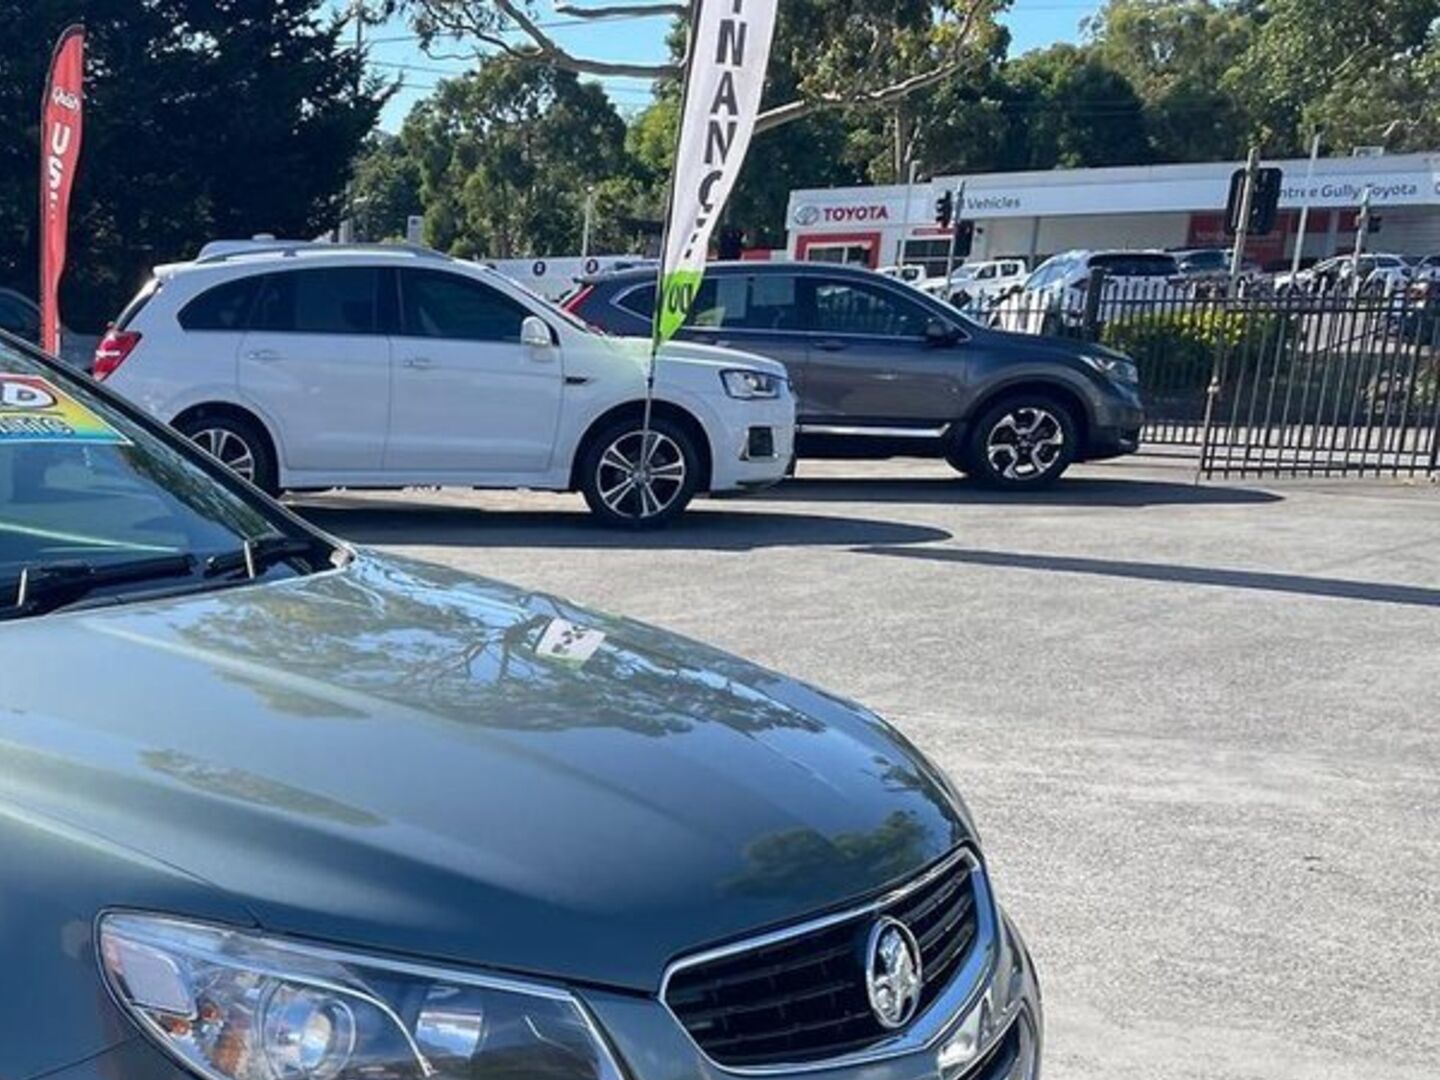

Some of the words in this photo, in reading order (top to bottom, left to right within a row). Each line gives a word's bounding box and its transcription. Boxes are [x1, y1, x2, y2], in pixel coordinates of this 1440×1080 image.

[1321, 183, 1360, 201] Gully
[966, 196, 1021, 210] Vehicles
[823, 205, 889, 222] TOYOTA
